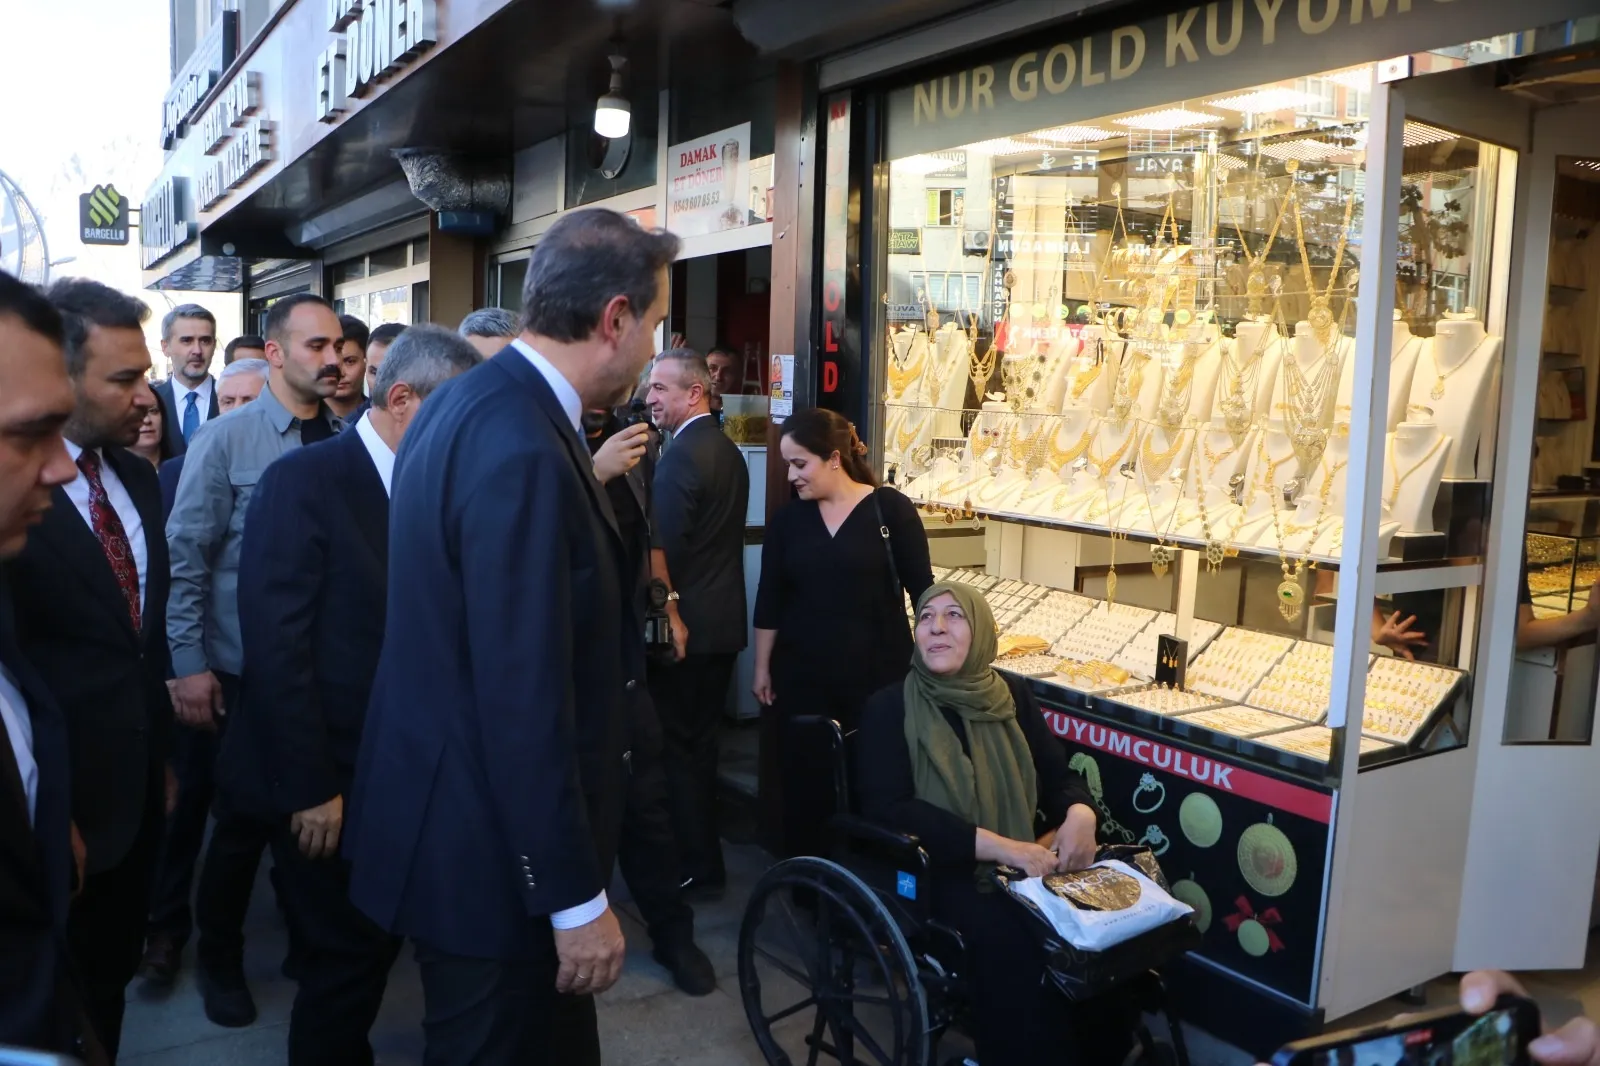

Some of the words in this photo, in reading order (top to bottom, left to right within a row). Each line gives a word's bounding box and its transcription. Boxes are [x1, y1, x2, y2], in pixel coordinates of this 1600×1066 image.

[316, 38, 338, 122] ET
[913, 65, 995, 127] NUR
[1009, 25, 1146, 101] GOLD
[680, 143, 718, 168] DAMAK
[84, 227, 125, 241] BARGELLO
[823, 238, 844, 392] GOLD
